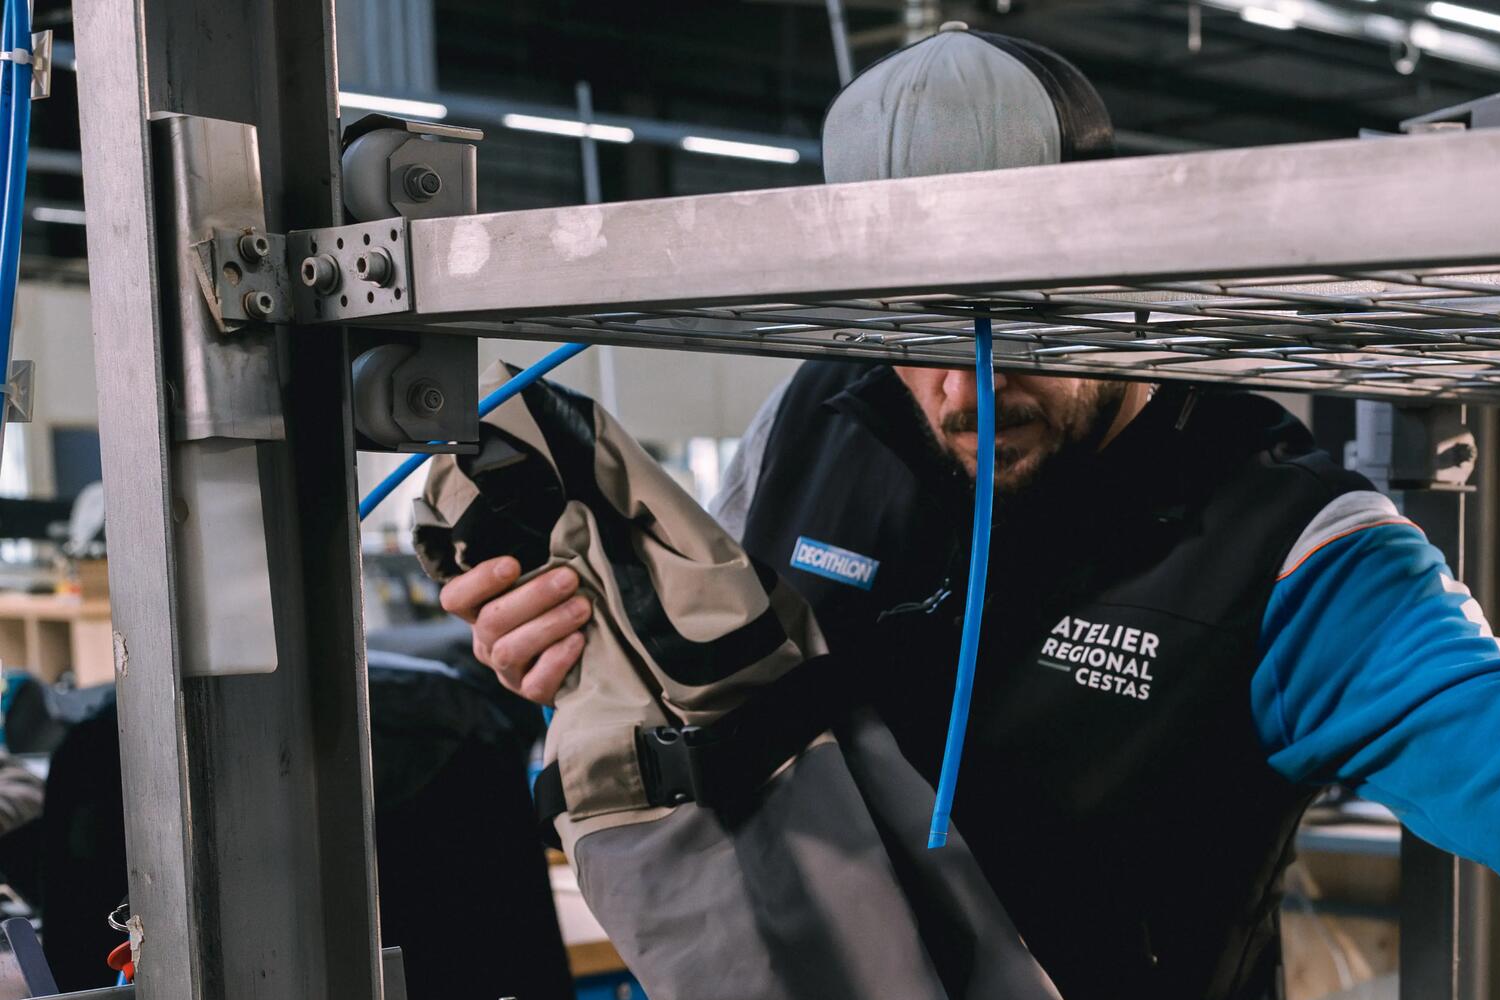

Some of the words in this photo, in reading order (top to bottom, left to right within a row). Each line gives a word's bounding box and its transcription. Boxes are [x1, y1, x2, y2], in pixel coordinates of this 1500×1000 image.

[797, 543, 873, 583] DECATHLON
[1050, 615, 1160, 658] ATELIER
[1041, 638, 1153, 681] REGIONAL
[1074, 667, 1151, 700] CESTAS
